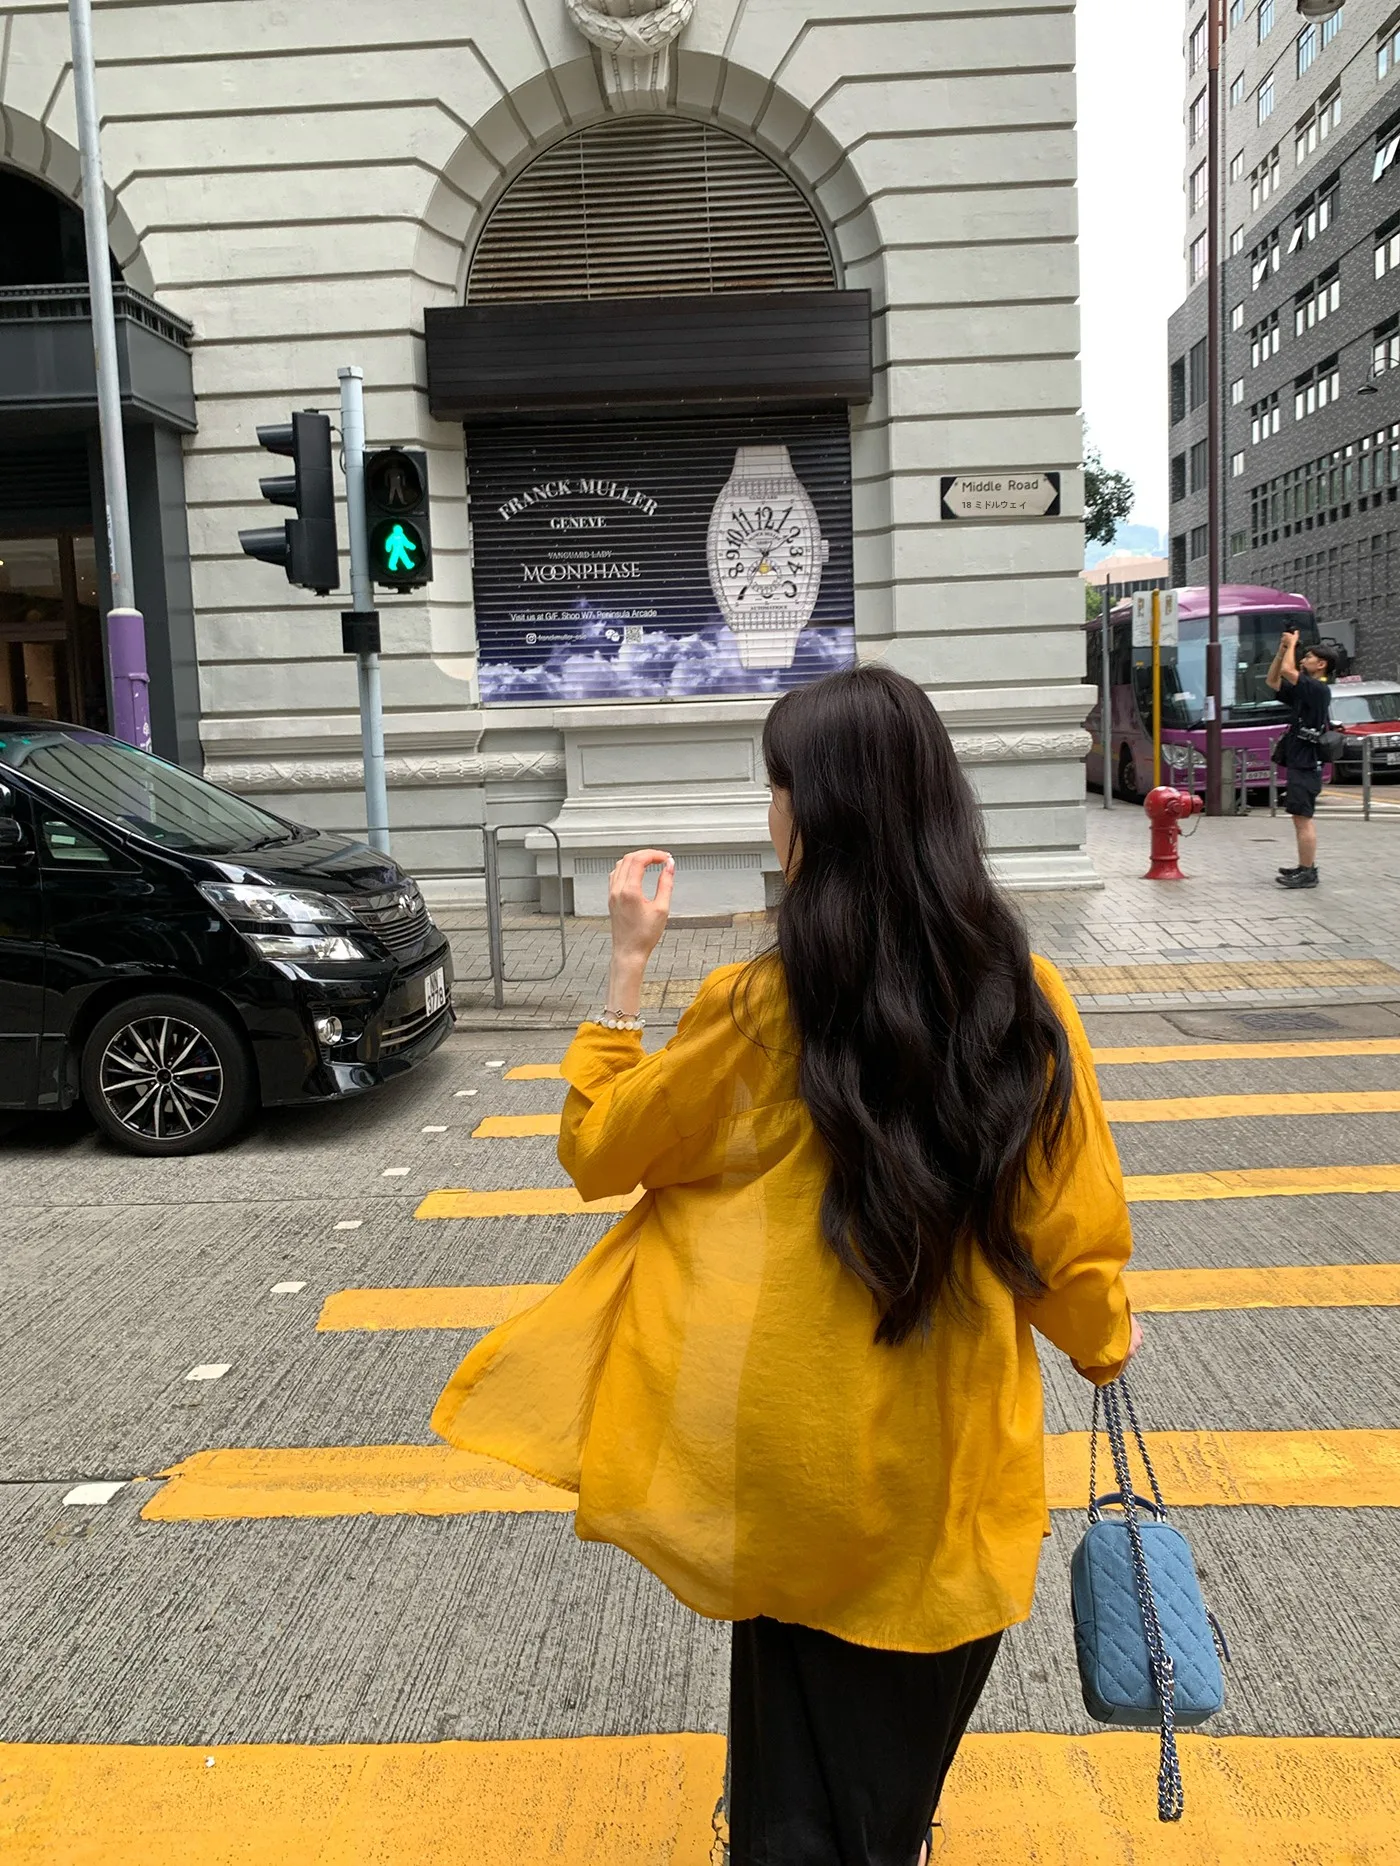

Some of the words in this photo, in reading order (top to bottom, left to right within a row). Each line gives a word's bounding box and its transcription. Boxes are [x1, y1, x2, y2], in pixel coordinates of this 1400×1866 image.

[962, 481, 1002, 492] Middle
[1008, 479, 1039, 491] Road
[498, 479, 572, 521] FRANCK
[579, 478, 659, 517] MULLER
[962, 501, 972, 509] 18
[975, 500, 1027, 510] ミドルウェイ
[550, 516, 607, 529] GENEVE
[755, 506, 774, 531] 12
[775, 506, 793, 534] 1
[726, 529, 745, 548] 10
[726, 549, 740, 560] 9
[789, 546, 804, 557] 3
[522, 561, 641, 584] MOONPHASE
[728, 562, 744, 579] 8
[787, 561, 803, 577] 4
[510, 613, 526, 621] Visit
[561, 611, 580, 621] Shop
[596, 610, 630, 619] Peninsula
[631, 609, 658, 618] Arcade
